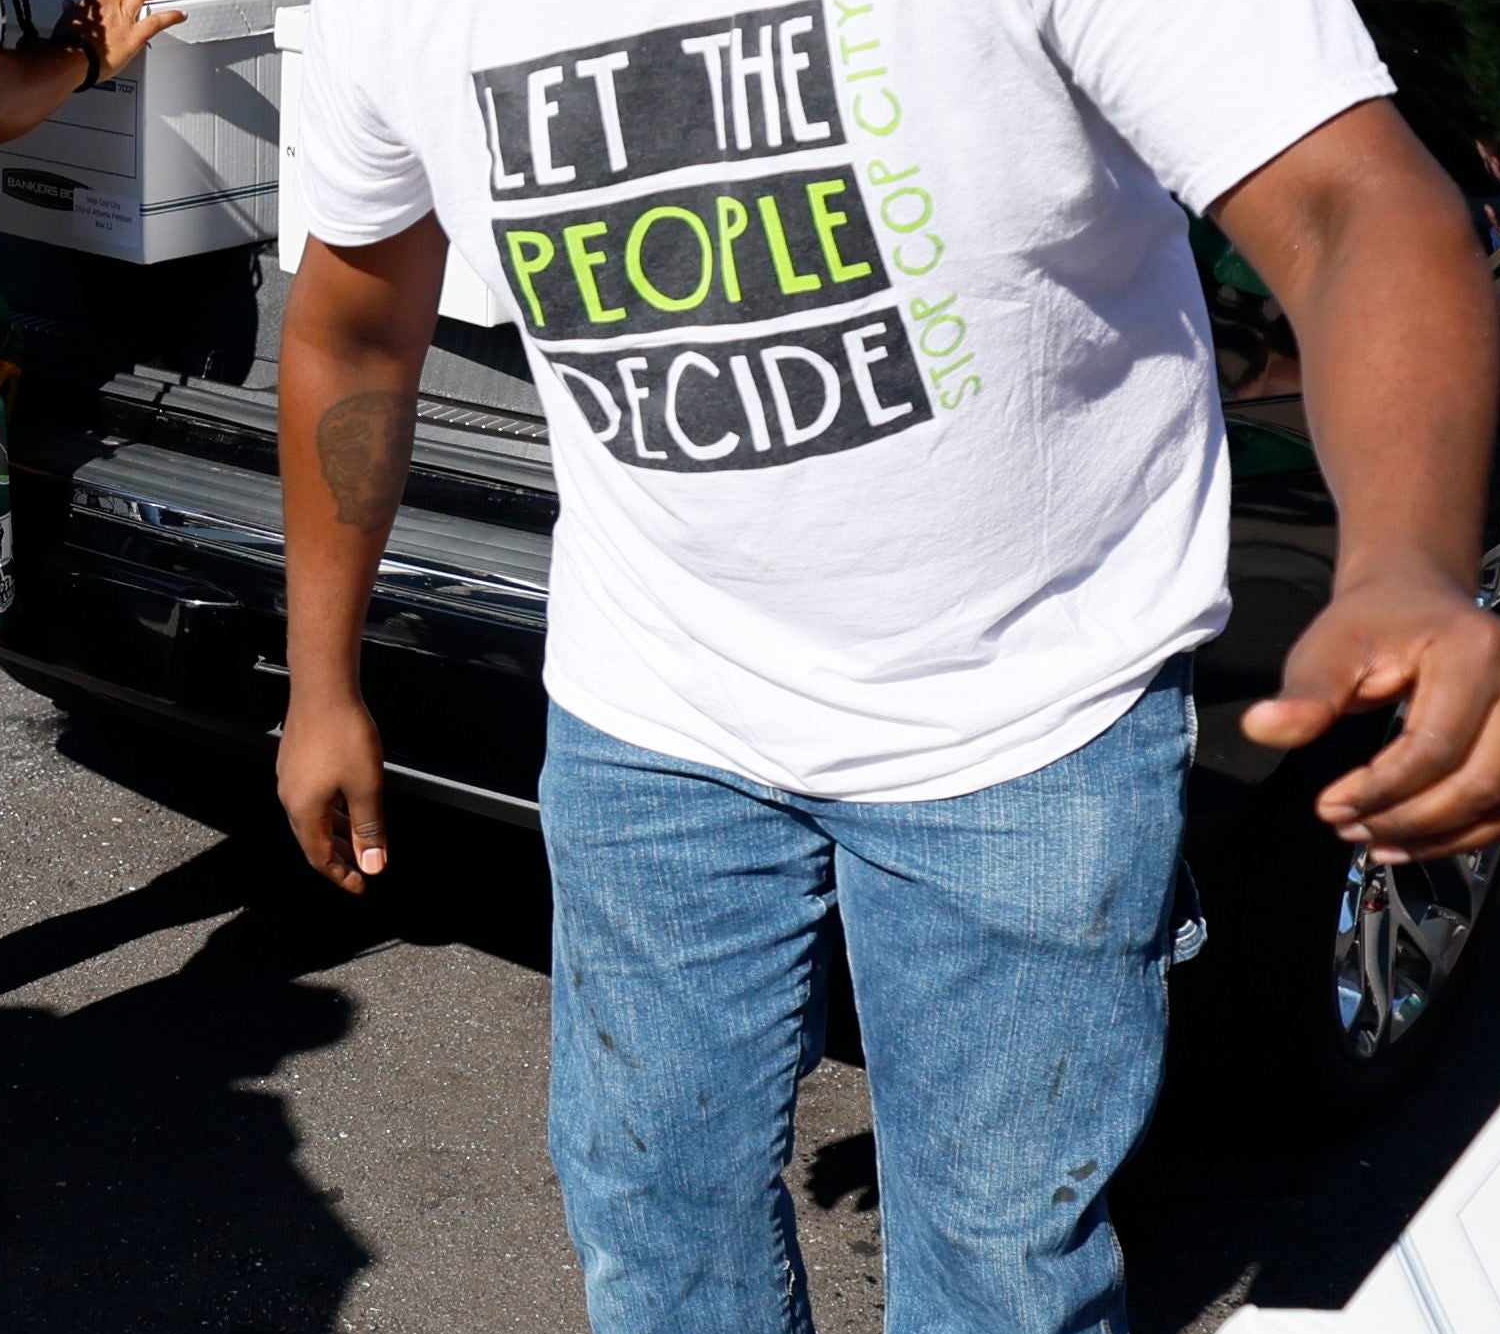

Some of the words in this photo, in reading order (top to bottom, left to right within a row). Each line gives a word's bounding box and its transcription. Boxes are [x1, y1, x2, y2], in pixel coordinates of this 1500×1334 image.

[484, 50, 630, 190] LET
[681, 15, 831, 151] THE
[7, 177, 58, 197] BANKERS
[60, 188, 74, 200] BO
[506, 179, 873, 327] PEOPLE
[867, 158, 945, 277] COP
[551, 322, 912, 461] DECIDE
[910, 290, 984, 412] STOP
